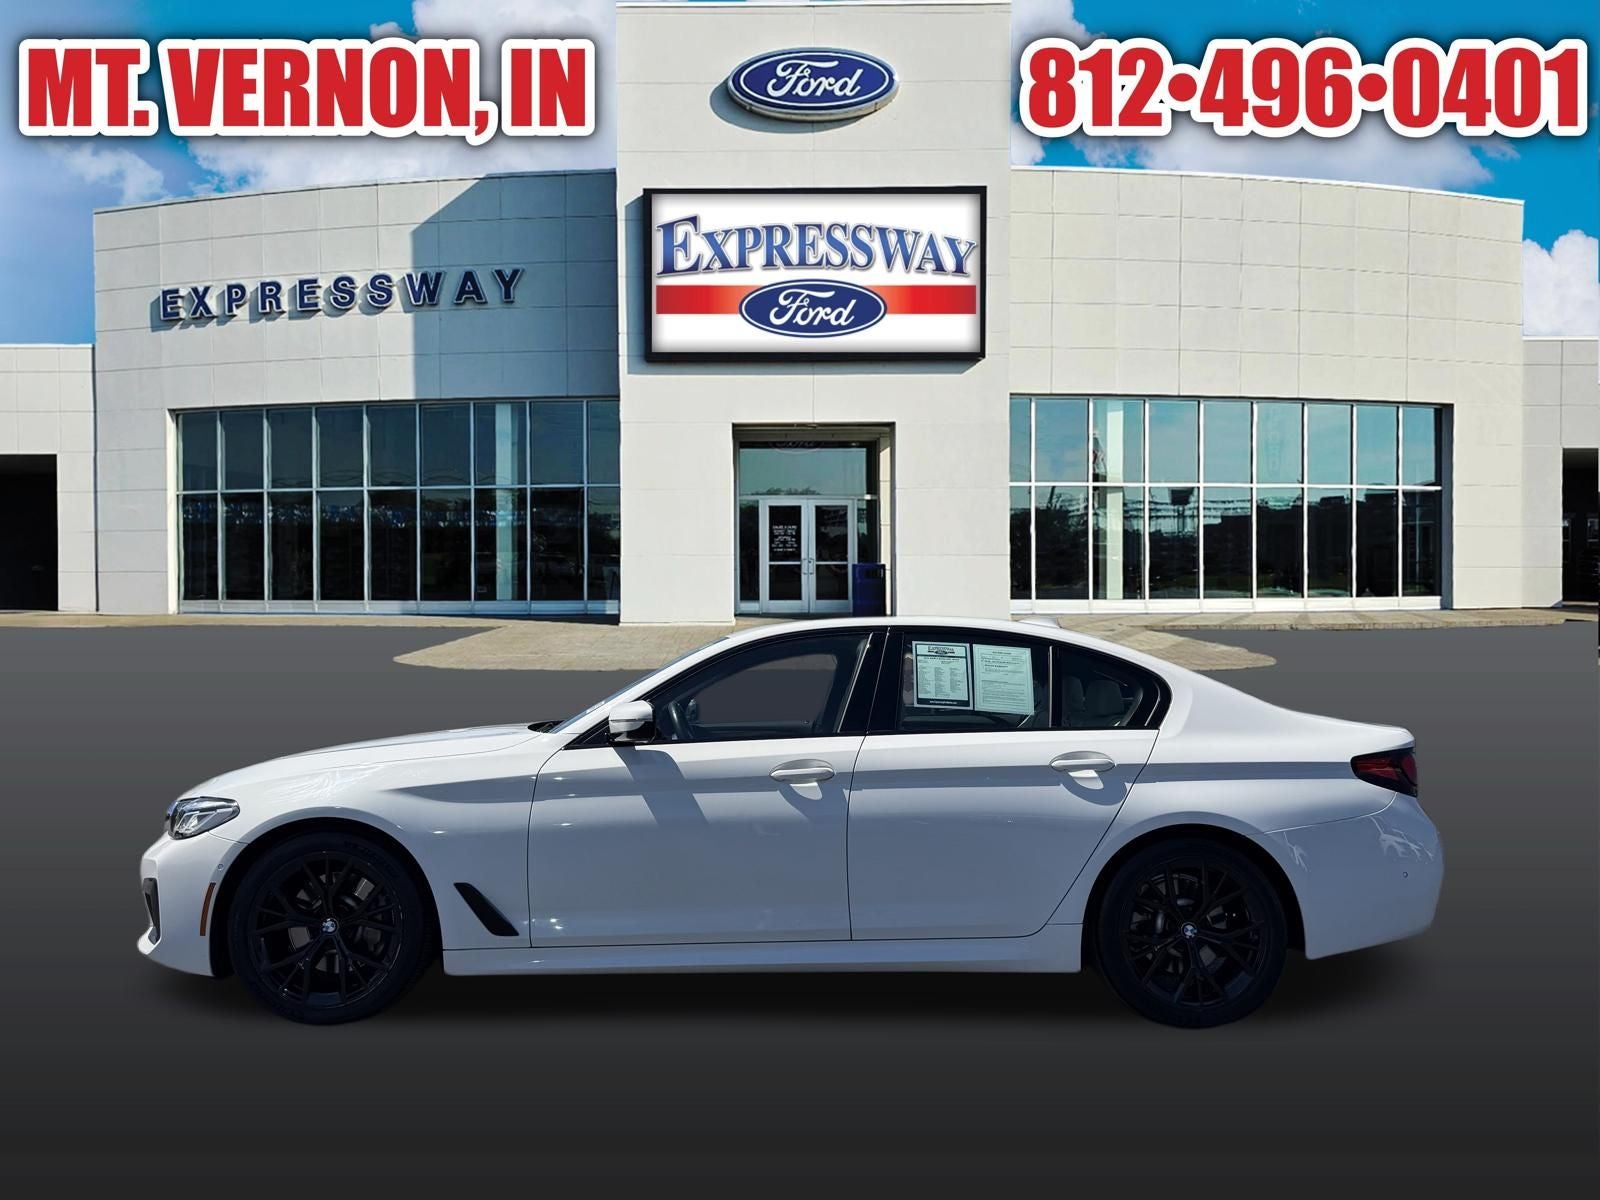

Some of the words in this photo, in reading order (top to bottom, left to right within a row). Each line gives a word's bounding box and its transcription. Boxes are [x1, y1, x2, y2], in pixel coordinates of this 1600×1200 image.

[766, 59, 864, 98] Ford
[656, 214, 978, 279] EXPRESSWAY
[159, 267, 525, 322] EXPRESSWAY
[769, 288, 858, 326] Ford
